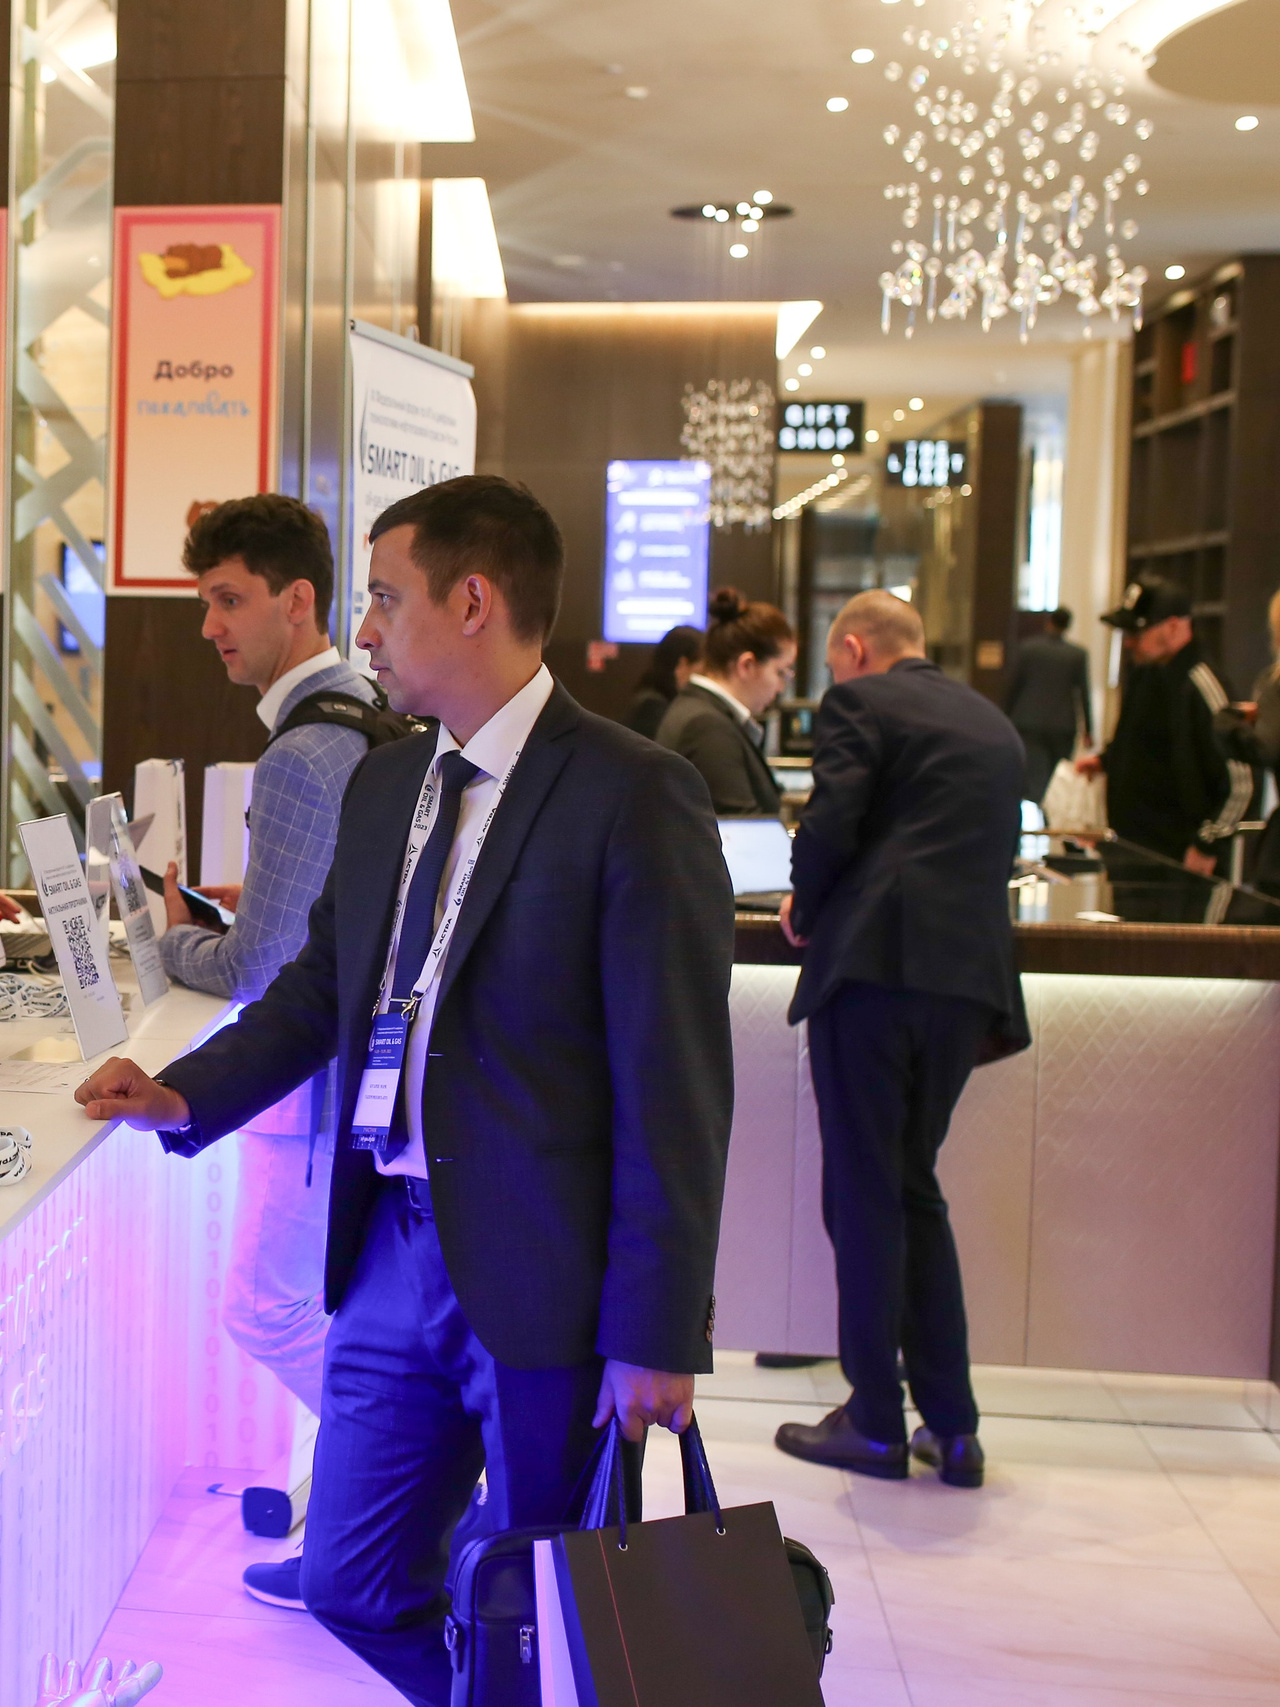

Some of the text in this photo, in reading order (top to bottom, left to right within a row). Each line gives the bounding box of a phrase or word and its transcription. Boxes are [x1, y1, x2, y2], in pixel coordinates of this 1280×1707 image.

[155, 361, 234, 381] Добро
[137, 391, 251, 416] пожаловать
[367, 444, 408, 481] SMART
[410, 455, 426, 485] OIL
[420, 792, 428, 803] OIL
[423, 794, 434, 817] SMART
[415, 809, 424, 823] GAS
[413, 823, 428, 831] 2023
[48, 882, 62, 895] SMART
[457, 873, 468, 895] SMART
[439, 918, 453, 944] АСТРА
